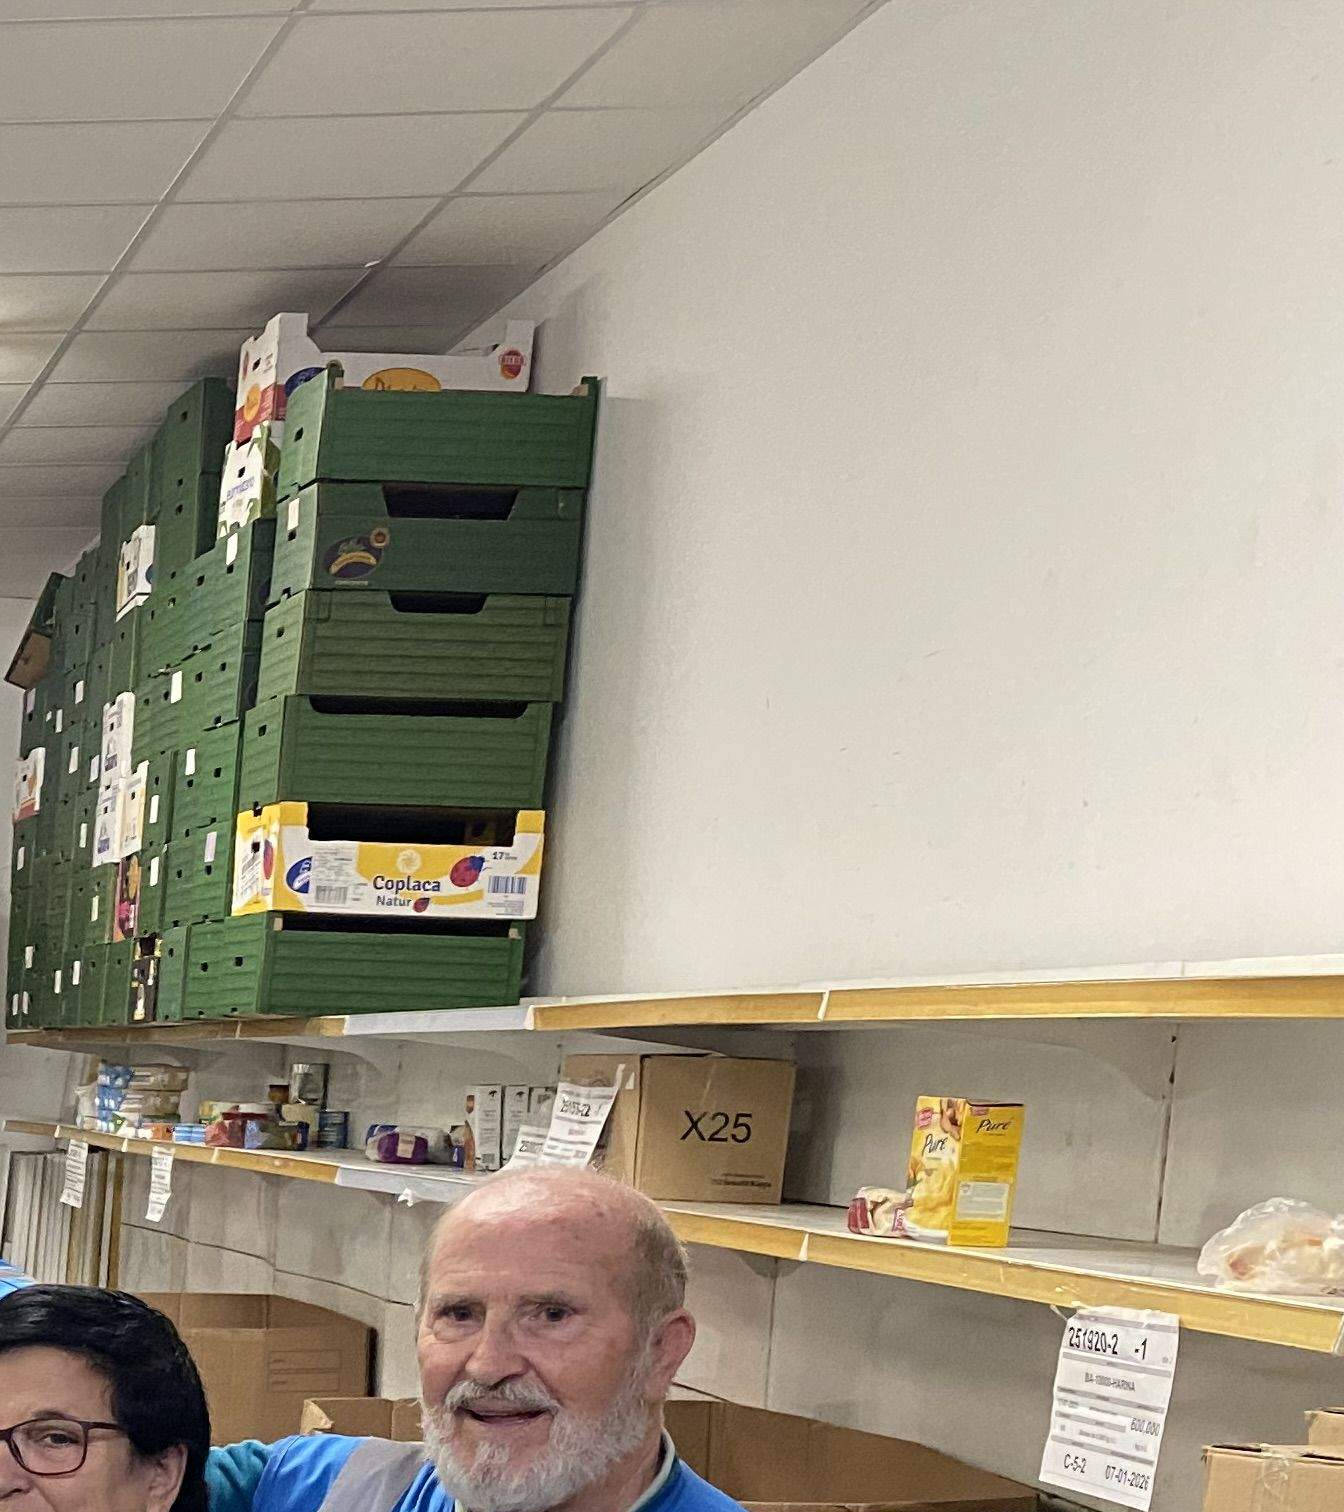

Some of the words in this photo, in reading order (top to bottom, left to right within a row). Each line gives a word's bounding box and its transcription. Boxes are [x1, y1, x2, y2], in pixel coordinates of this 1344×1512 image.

[372, 875, 441, 894] Coplaca
[376, 895, 412, 907] Natur
[680, 1110, 753, 1144] X25
[1068, 1326, 1119, 1356] 251920-2
[1064, 1453, 1088, 1474] C-5-2
